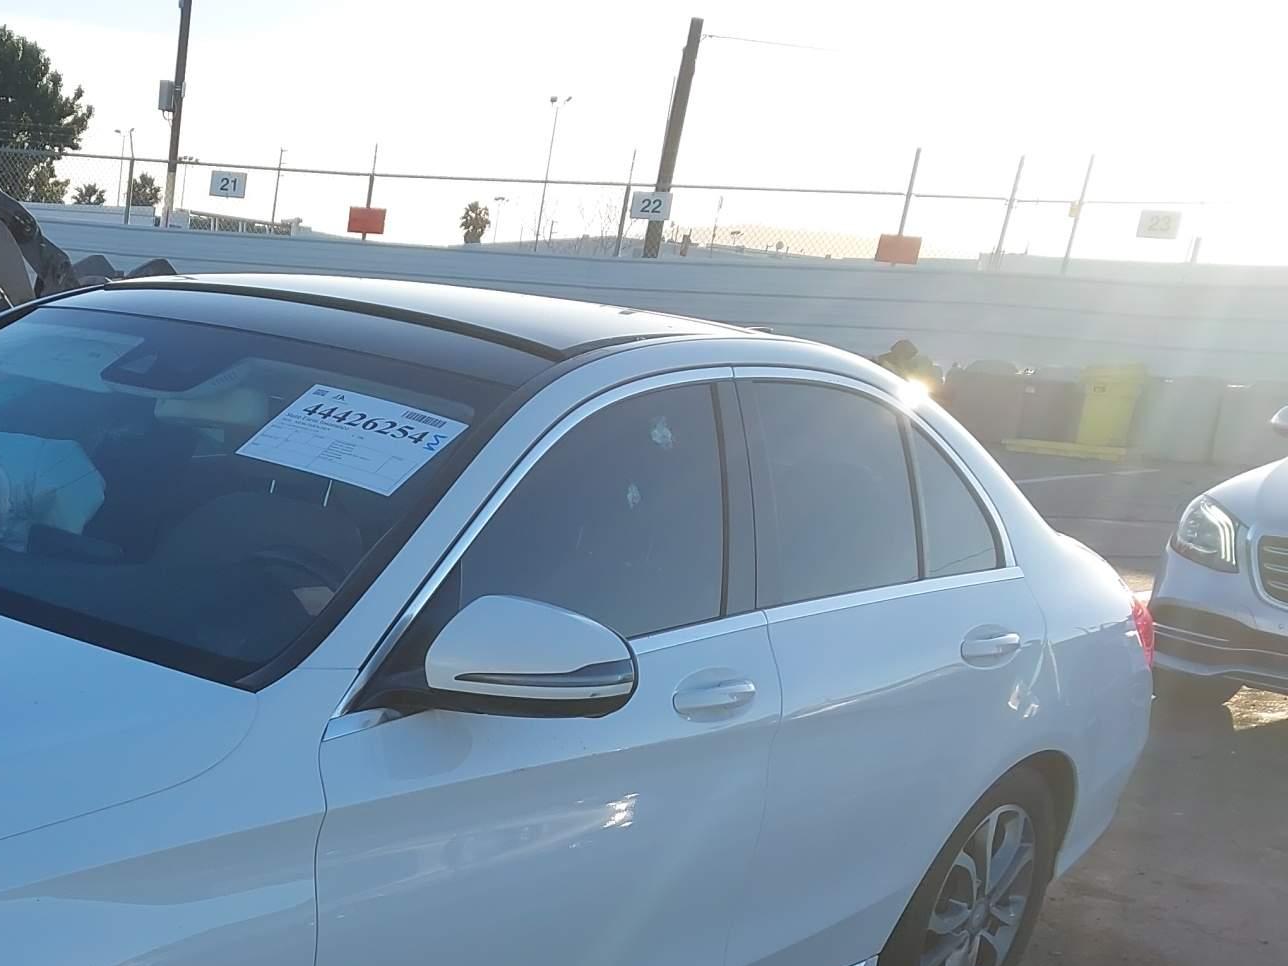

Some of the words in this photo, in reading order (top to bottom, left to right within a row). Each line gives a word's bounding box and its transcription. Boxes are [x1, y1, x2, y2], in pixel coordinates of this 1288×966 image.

[219, 177, 238, 192] 21
[639, 198, 663, 214] 22
[1146, 215, 1172, 231] 23
[302, 403, 430, 444] 44426254
